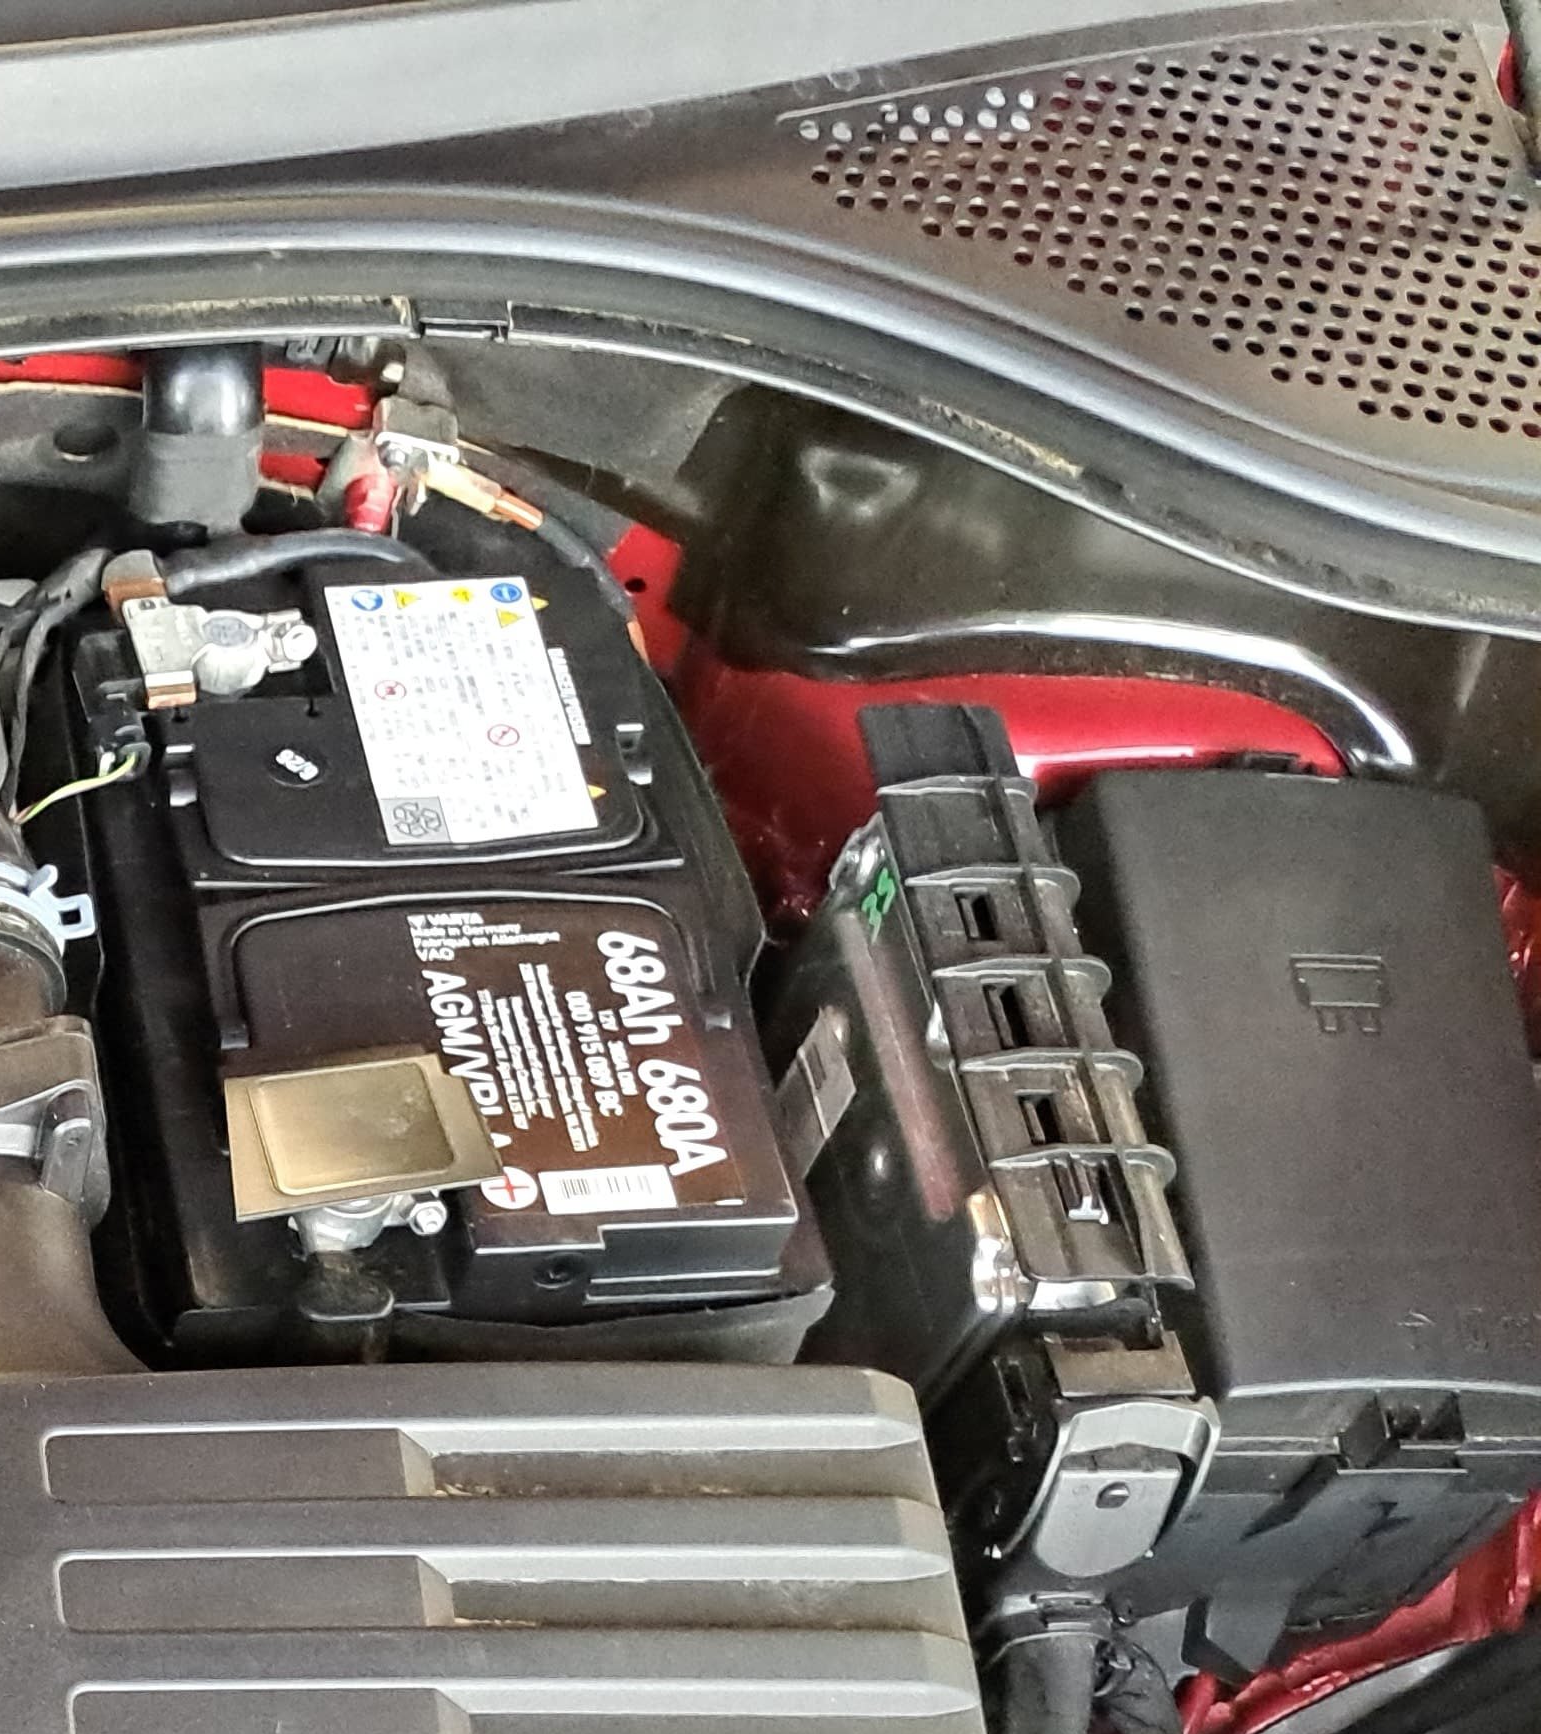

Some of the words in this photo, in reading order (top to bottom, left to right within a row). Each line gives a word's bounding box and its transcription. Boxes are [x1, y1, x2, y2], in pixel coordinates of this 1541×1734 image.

[574, 1024, 604, 1054] 915
[596, 930, 683, 1045] 68Ah
[637, 1058, 728, 1177] 680A
